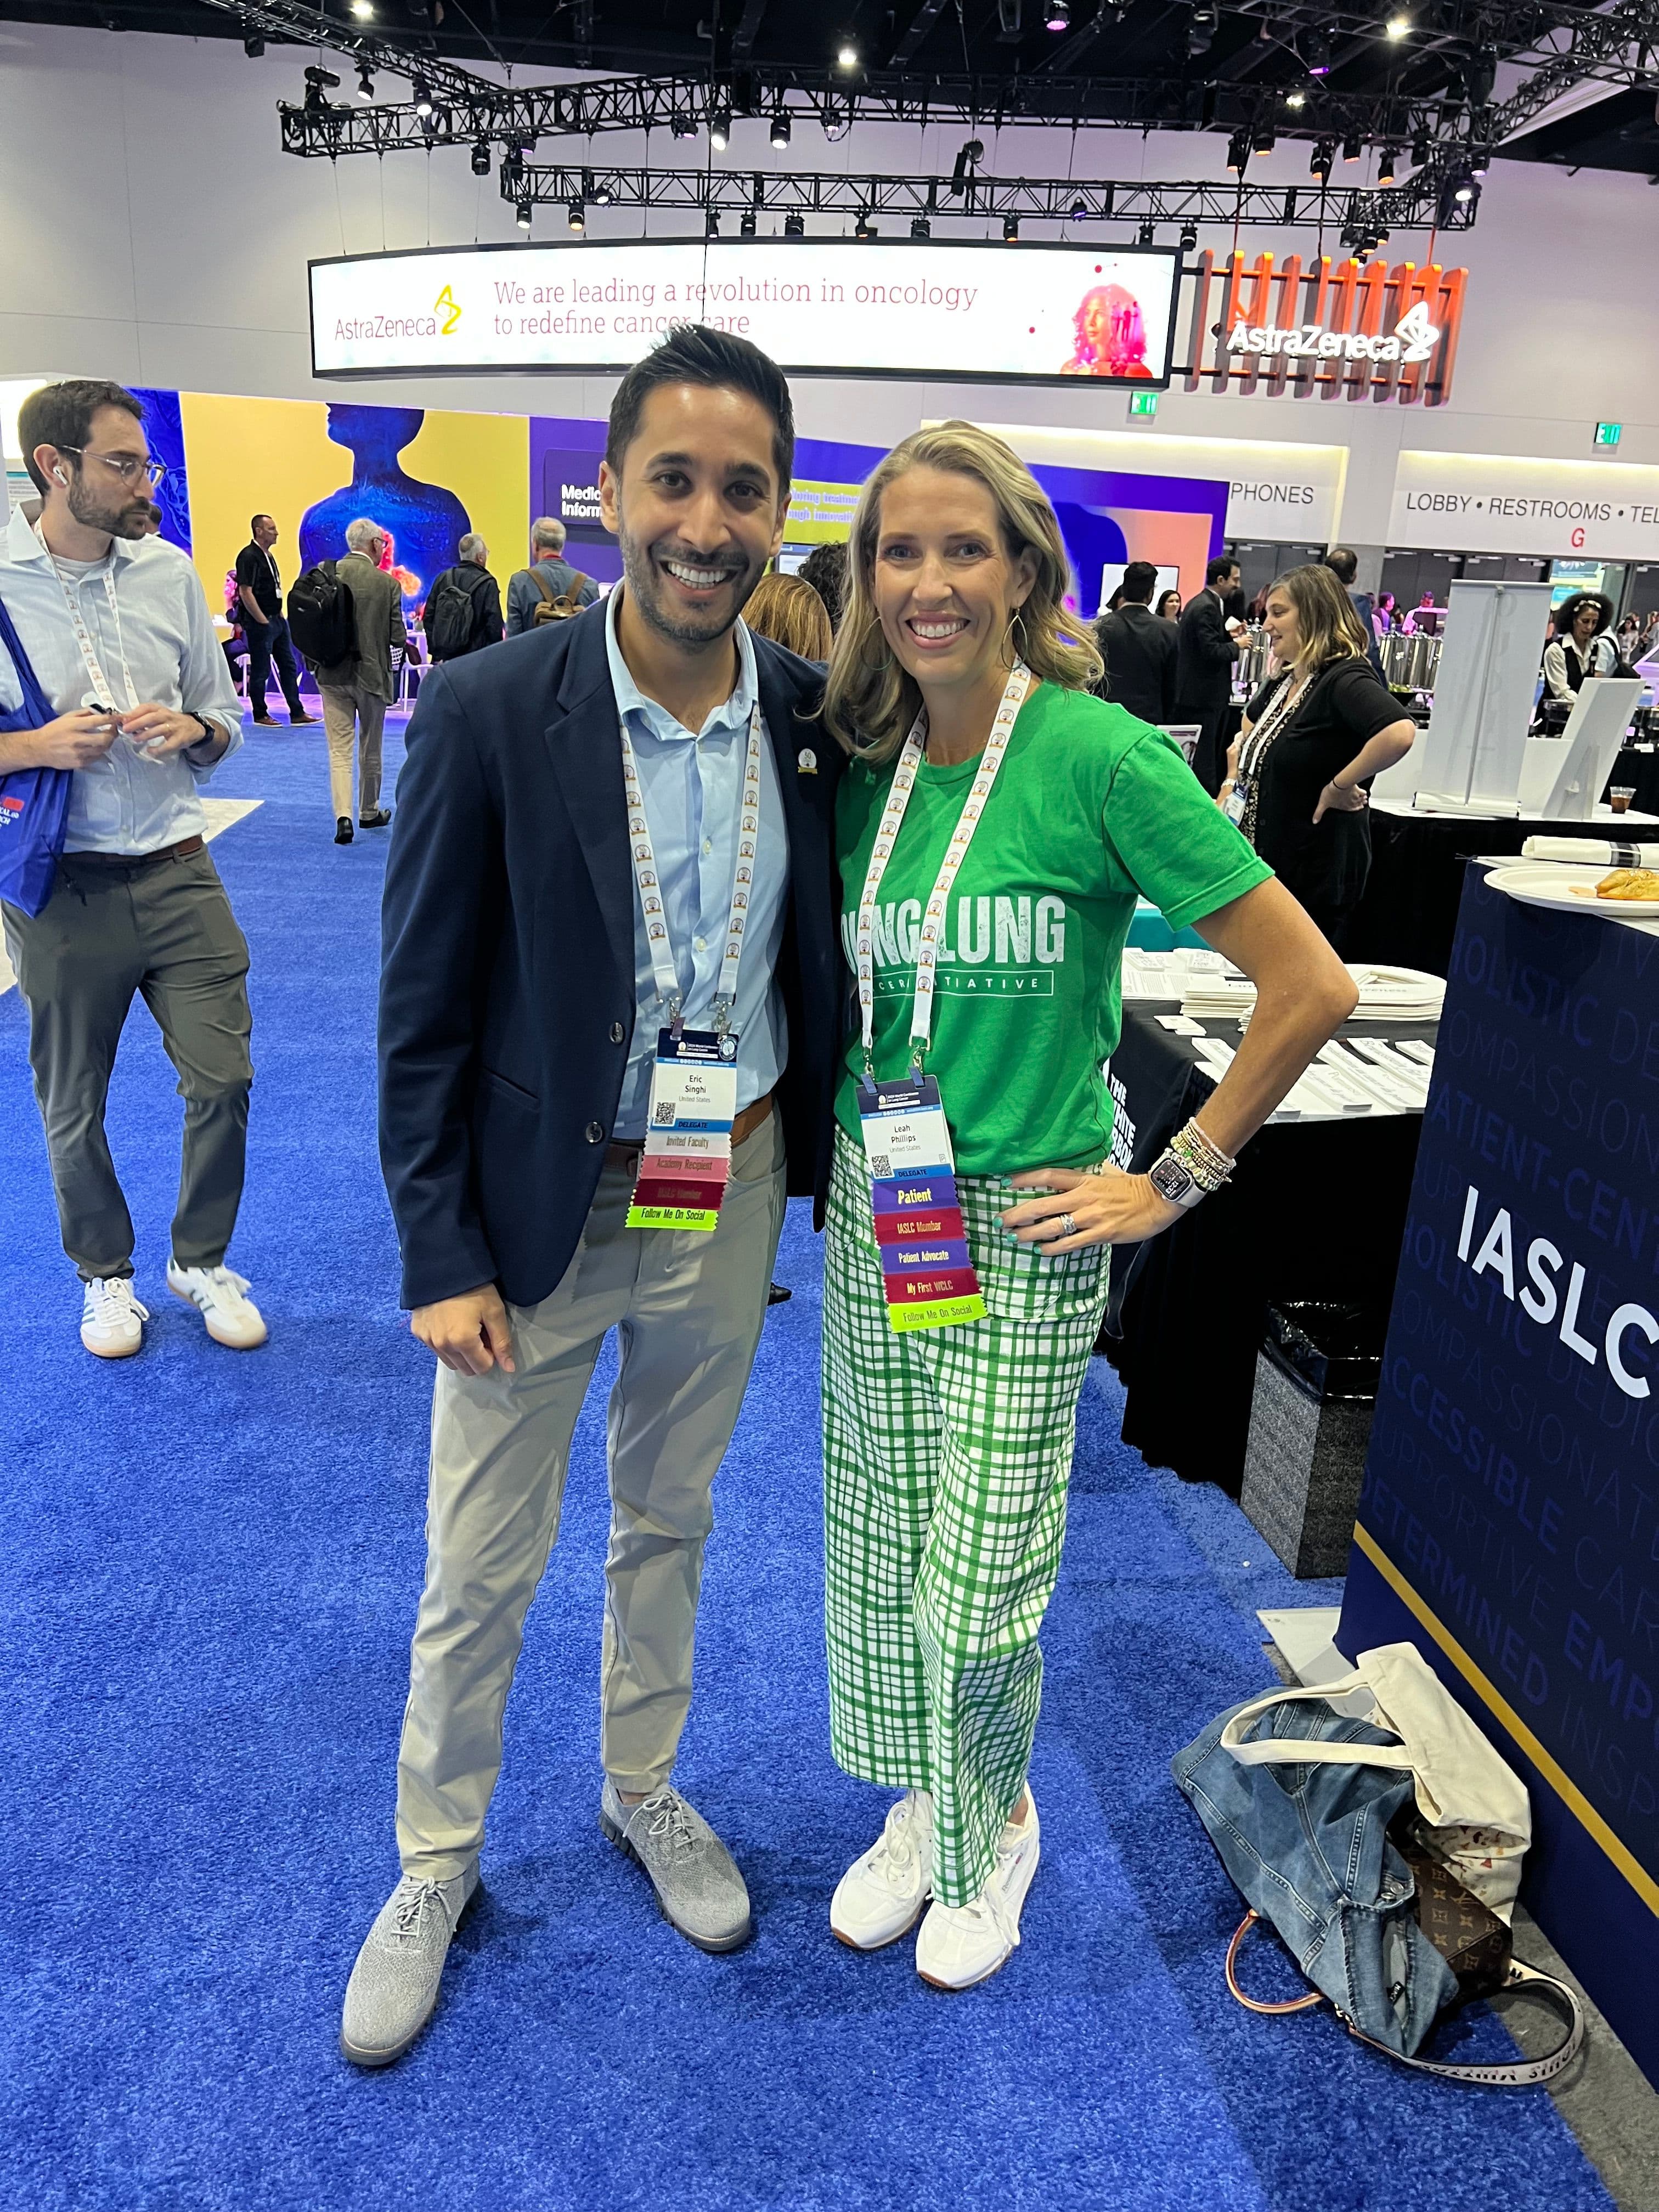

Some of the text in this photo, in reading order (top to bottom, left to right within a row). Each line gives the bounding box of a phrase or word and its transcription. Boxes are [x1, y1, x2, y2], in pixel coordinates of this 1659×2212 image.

[494, 276, 979, 311] We are leading a revolution in oncology
[334, 315, 437, 342] AstraZeneca
[494, 313, 512, 335] to
[520, 309, 606, 335] redefine
[1226, 322, 1400, 362] AstraZeneca
[1596, 424, 1622, 444] EXIT
[1230, 483, 1314, 505] PHONES
[1407, 492, 1472, 513] LOBBY
[1488, 498, 1611, 522] RESTROOMS
[1571, 528, 1585, 548] G
[689, 1075, 702, 1083] Eric
[685, 1085, 707, 1094] Singhi
[1110, 1073, 1127, 1107] THE
[894, 1125, 911, 1133] Leah
[666, 1136, 709, 1149] Invited Faculty
[891, 1135, 917, 1143] Phillips
[656, 1157, 713, 1171] Academy Recipient
[898, 1169, 928, 1177] DELEGATE
[897, 1187, 933, 1205] Patient
[641, 1207, 706, 1221] Follow Me On Social
[897, 1220, 941, 1234] IASLC Member
[898, 1250, 950, 1263] Patient Advocate
[906, 1279, 953, 1295] My First WCLC
[1457, 1185, 1659, 1399] IASLC
[902, 1304, 973, 1322] Follow Me On Social
[1383, 1354, 1564, 1555] CCESSIBLE
